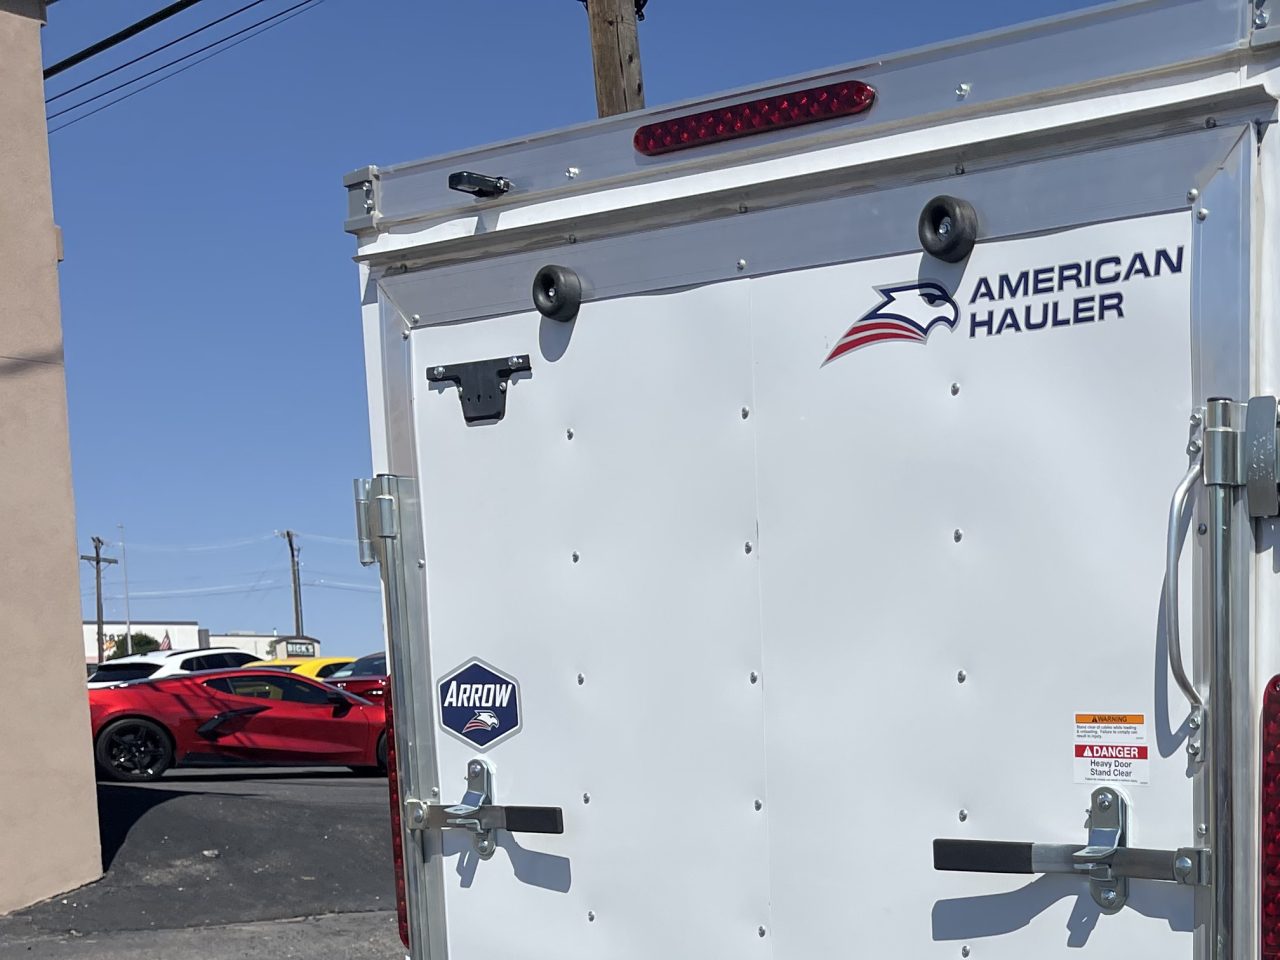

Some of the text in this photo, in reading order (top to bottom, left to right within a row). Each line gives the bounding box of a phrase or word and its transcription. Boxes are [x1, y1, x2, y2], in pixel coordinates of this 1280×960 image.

[968, 245, 1185, 304] AMERICAN
[969, 292, 1125, 338] HAULER
[443, 680, 513, 707] ARROW
[1098, 715, 1128, 723] WARNING
[1093, 746, 1138, 758] DANGER
[1090, 759, 1132, 769] Heavy Door
[1090, 768, 1132, 777] Stand Clear
